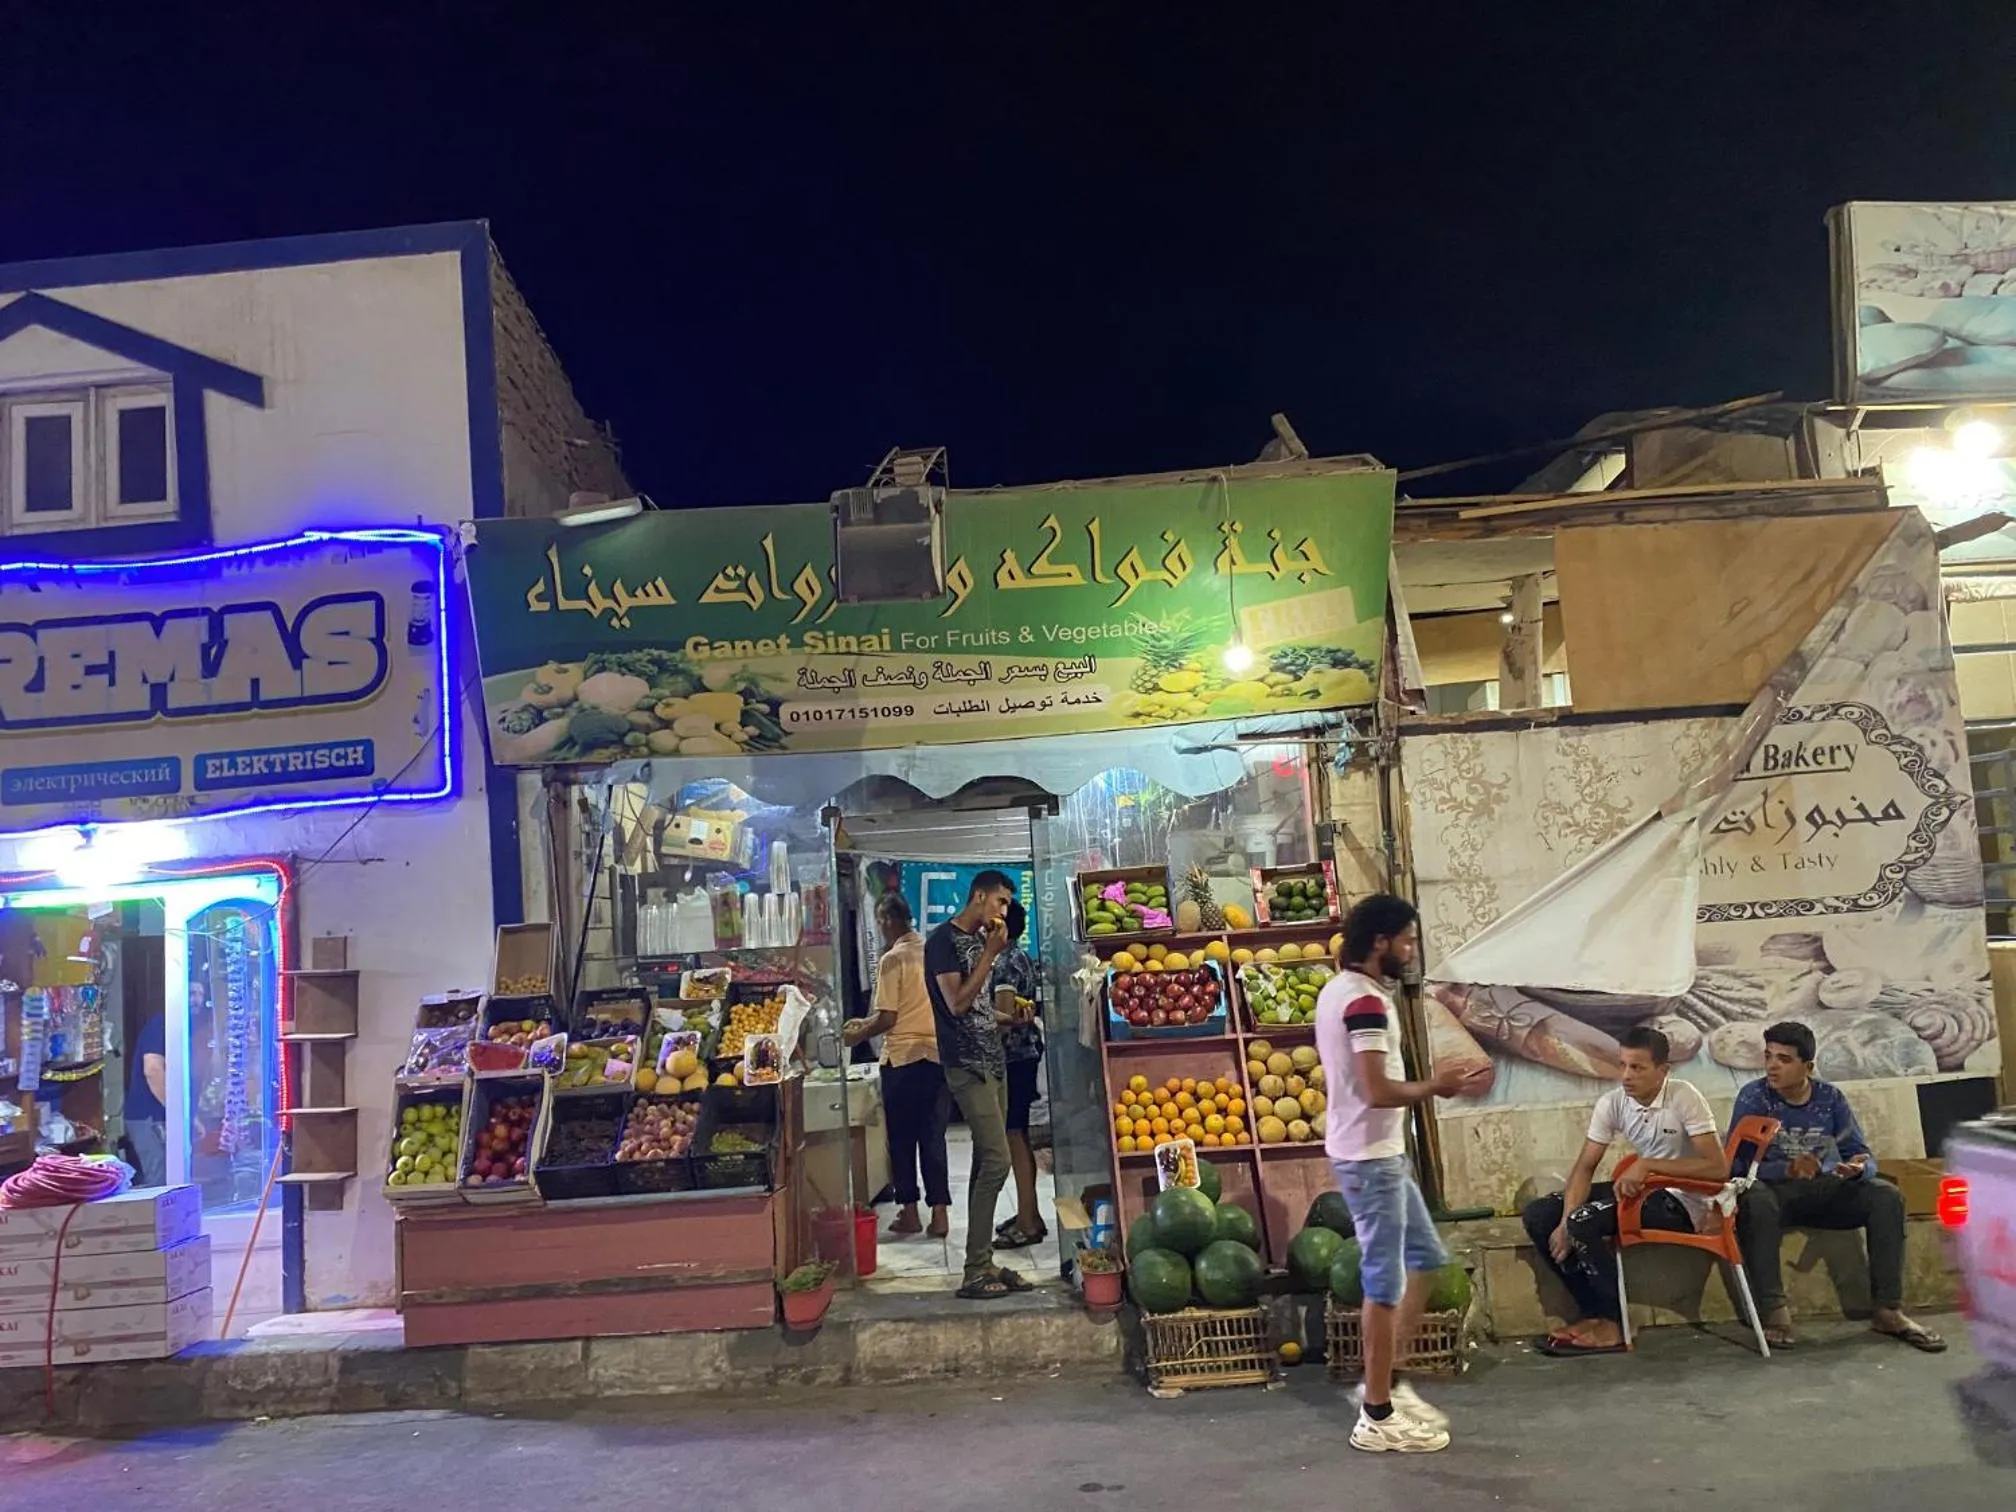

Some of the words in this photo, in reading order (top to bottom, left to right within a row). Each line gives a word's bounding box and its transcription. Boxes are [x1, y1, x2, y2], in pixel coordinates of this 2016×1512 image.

[1214, 519, 1334, 583] جنة
[526, 540, 678, 630] سيناء
[685, 633, 791, 660] Ganet
[803, 628, 893, 654] Sinai
[901, 631, 938, 650] For
[946, 626, 1010, 648] Fruits
[1018, 625, 1034, 644] &
[1042, 618, 1171, 646] Vegetables
[796, 668, 857, 692] الجملة
[862, 667, 928, 690] ونصف
[931, 661, 992, 686] الجملة
[998, 662, 1048, 683] بسعر
[1053, 655, 1096, 682] البيع
[933, 699, 990, 716] الطلبات
[998, 695, 1054, 715] توصيل
[1059, 691, 1103, 706] خدمة
[789, 704, 915, 723] 01017151099
[205, 745, 365, 779] ELEKTRISCH
[1762, 741, 1858, 772] Bakery
[10, 763, 171, 793] электрический
[1709, 785, 1906, 846] مخبوزات
[1700, 855, 1738, 879] hly
[1750, 854, 1766, 873] &
[1777, 850, 1840, 871] Tasty
